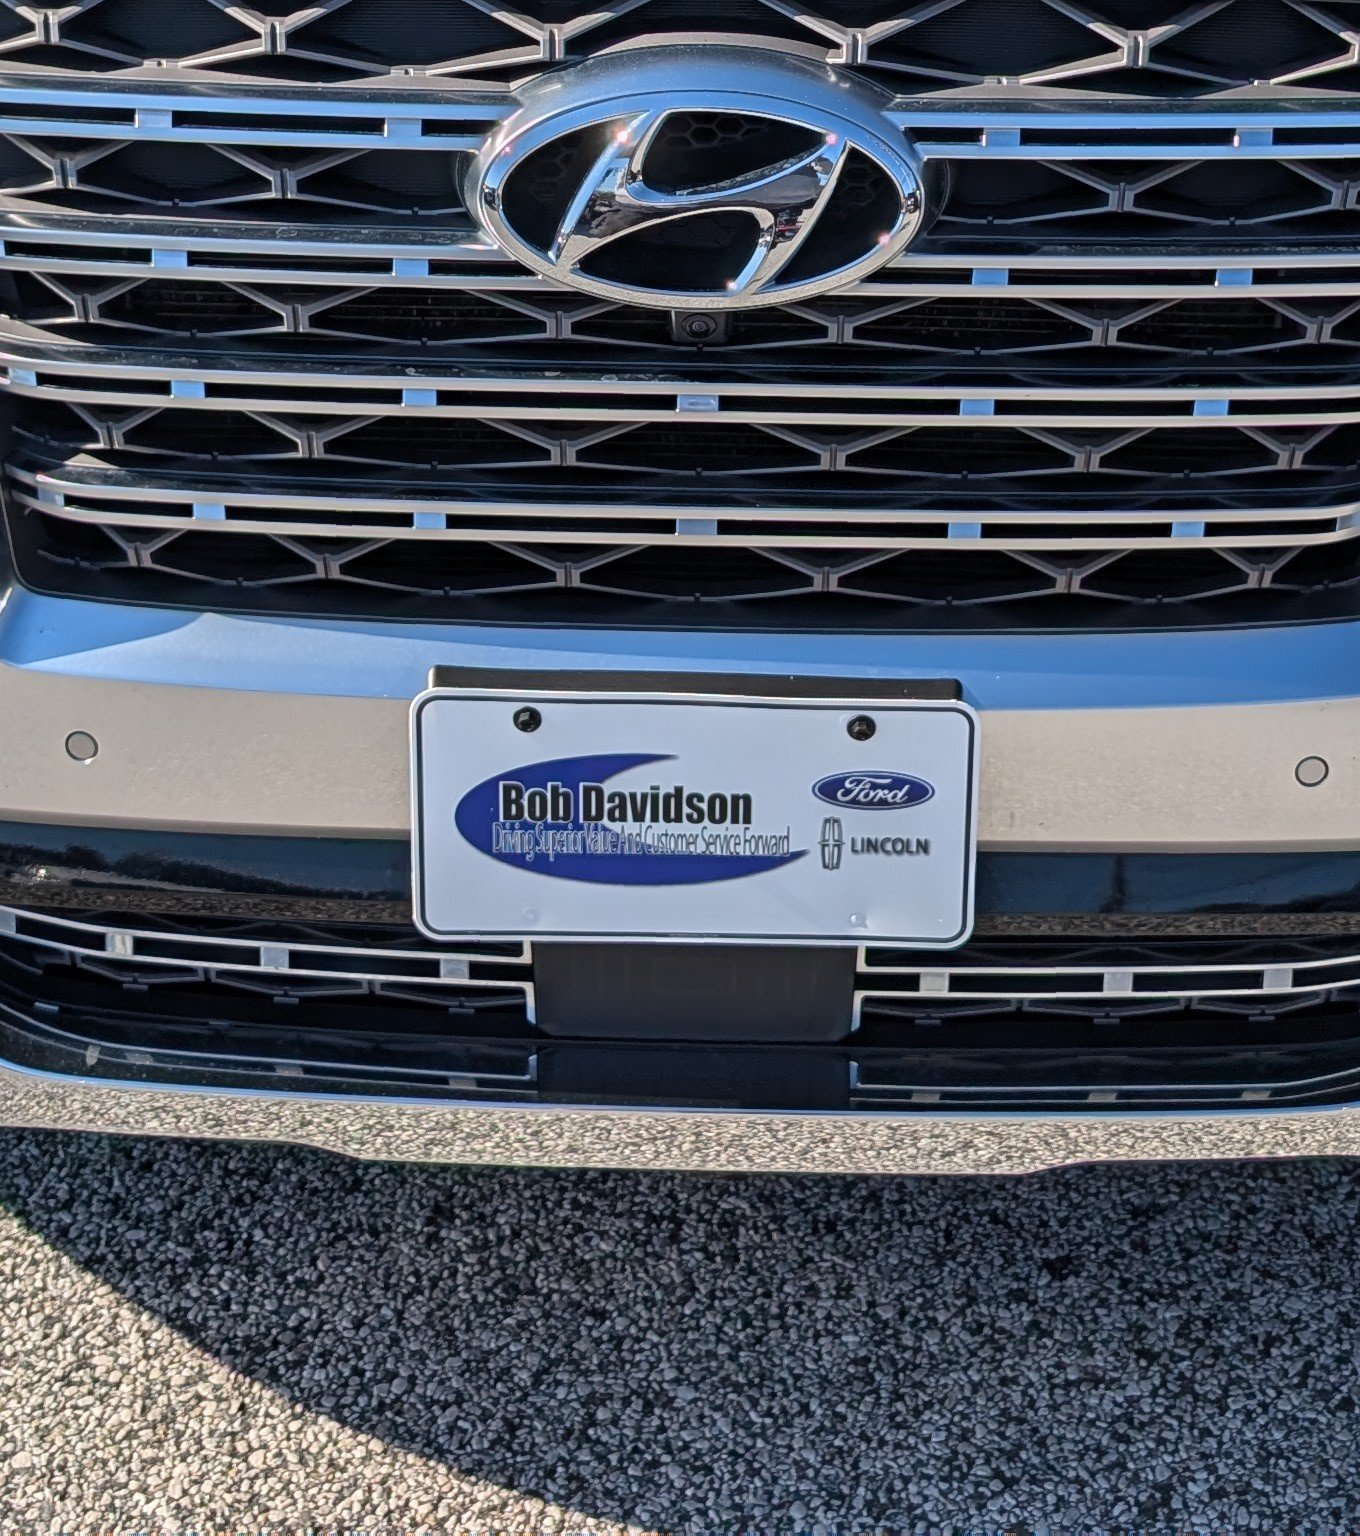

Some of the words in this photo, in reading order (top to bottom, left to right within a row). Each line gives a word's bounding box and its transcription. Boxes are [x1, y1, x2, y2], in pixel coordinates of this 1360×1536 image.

[499, 781, 574, 823] Bob
[579, 782, 752, 825] Davidson
[836, 776, 911, 803] Ford
[492, 822, 535, 861] Driving
[535, 823, 586, 861] Superior
[584, 823, 617, 854] Value
[619, 825, 642, 855] And
[643, 825, 700, 855] Customer
[701, 825, 741, 856] Service
[743, 826, 791, 857] Forward
[850, 836, 930, 856] LINCOLN
